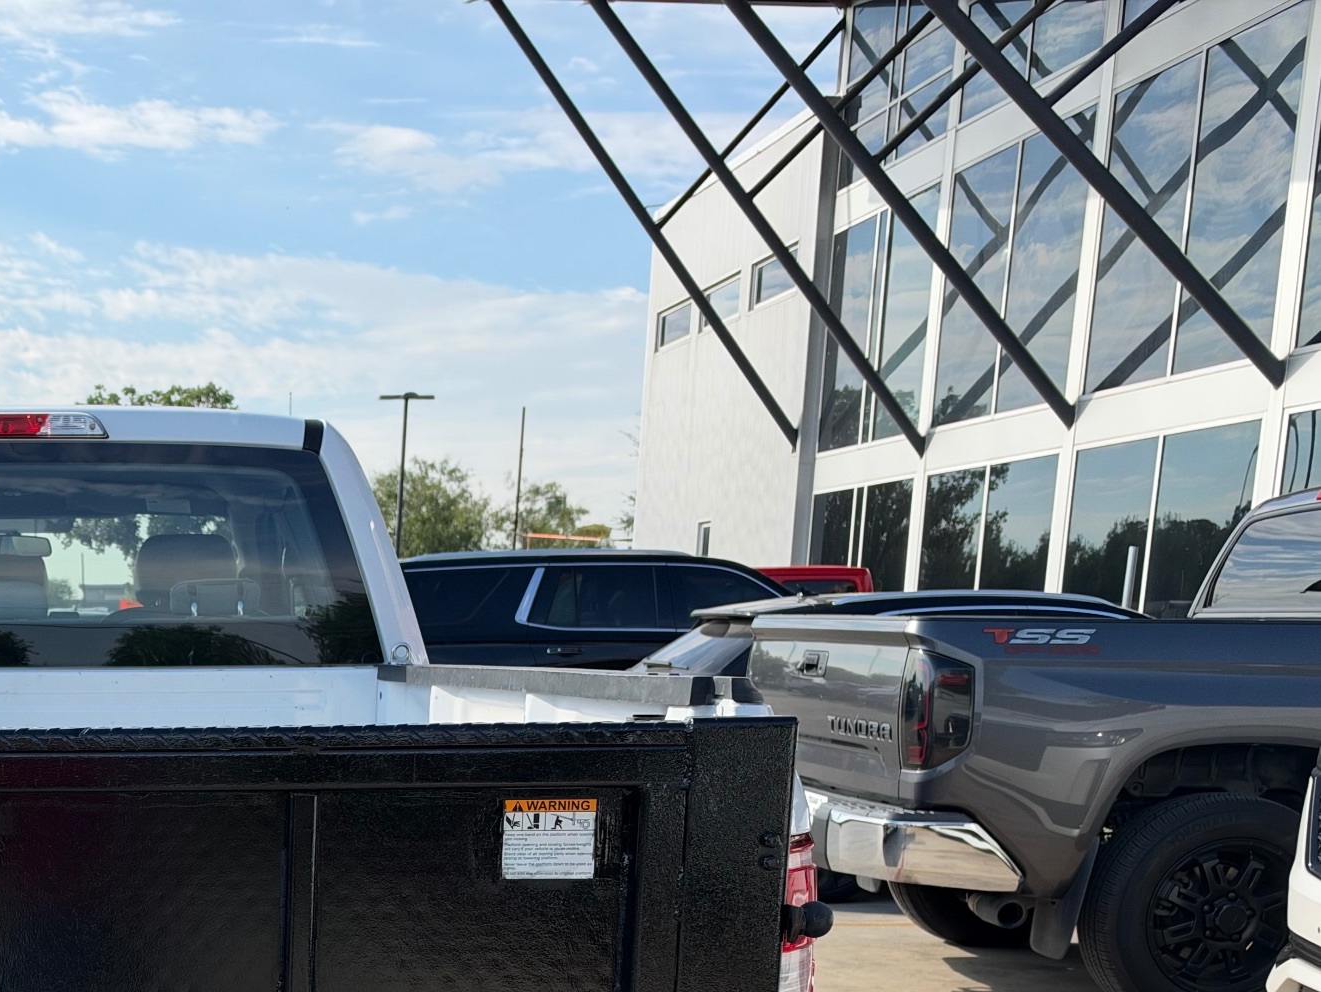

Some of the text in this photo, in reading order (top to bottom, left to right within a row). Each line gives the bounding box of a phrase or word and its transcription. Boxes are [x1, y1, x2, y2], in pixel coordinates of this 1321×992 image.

[983, 628, 1097, 645] TSS
[827, 714, 893, 743] TUNDRA
[526, 800, 590, 811] WARNING
